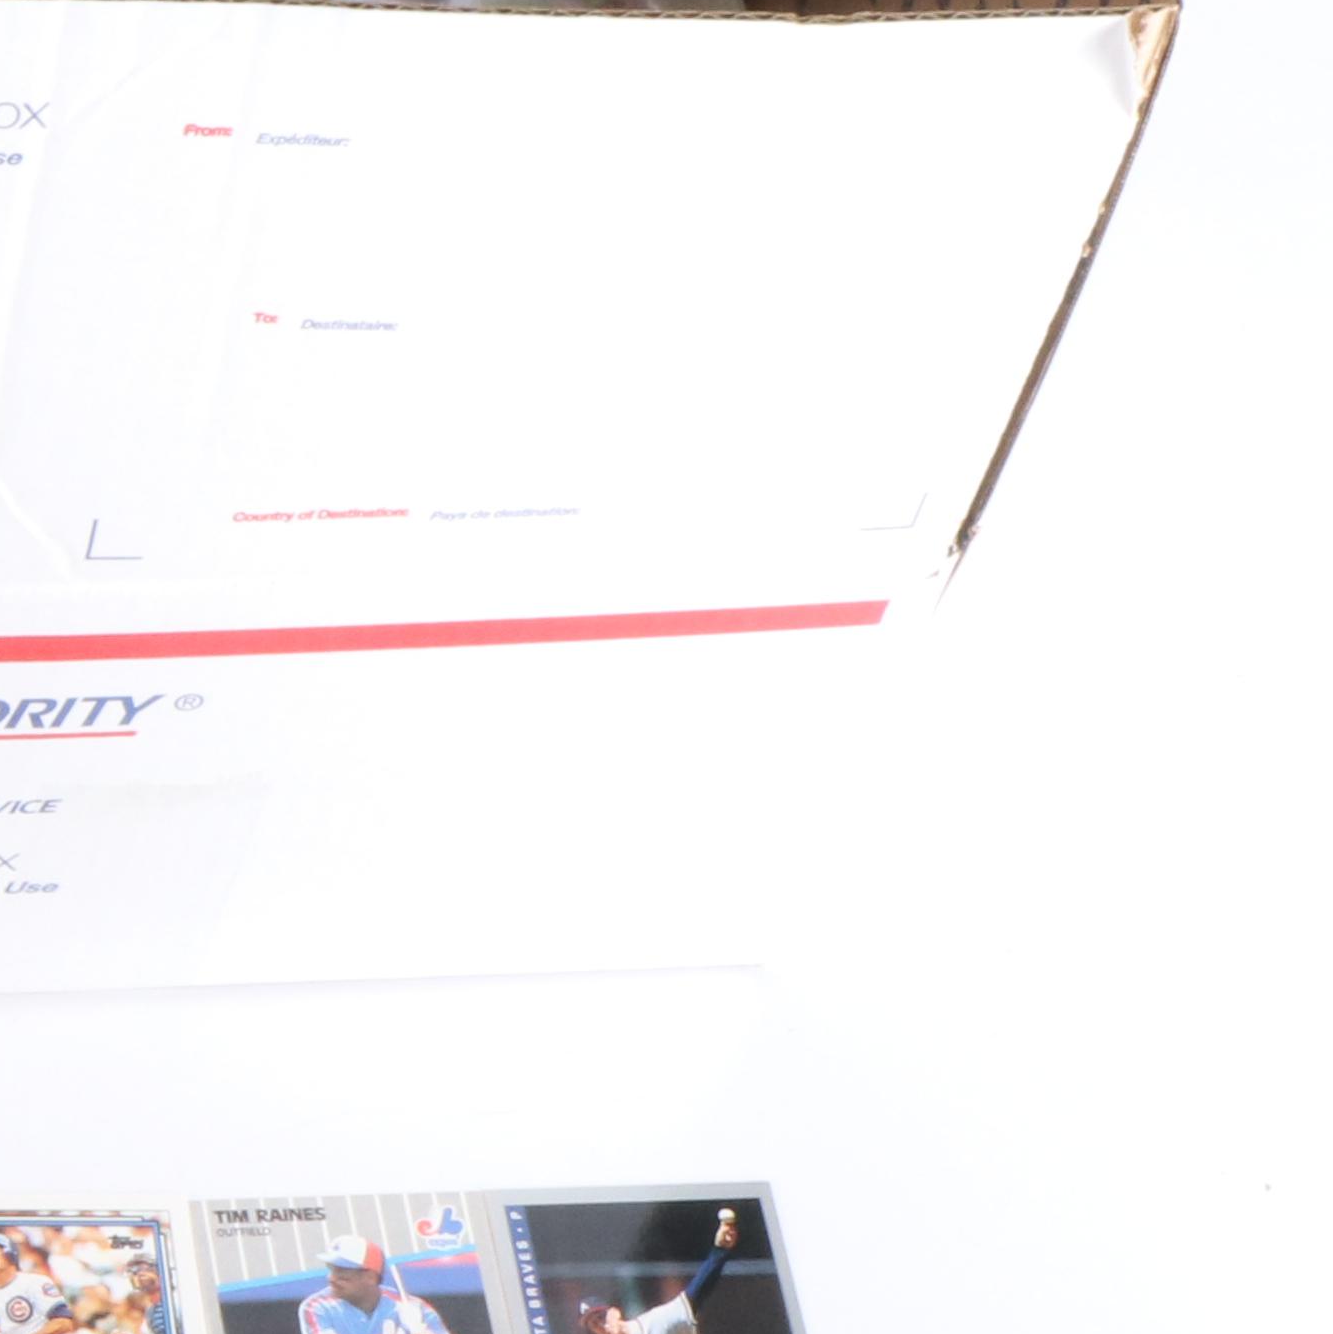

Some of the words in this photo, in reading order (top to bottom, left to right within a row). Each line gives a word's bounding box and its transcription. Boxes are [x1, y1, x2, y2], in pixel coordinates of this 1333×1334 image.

[10, 880, 60, 895] Use
[214, 1209, 249, 1224] TIM
[257, 1207, 326, 1222] RAINES
[216, 1226, 271, 1237] OUTFIELD
[516, 1240, 543, 1308] BRAVES
